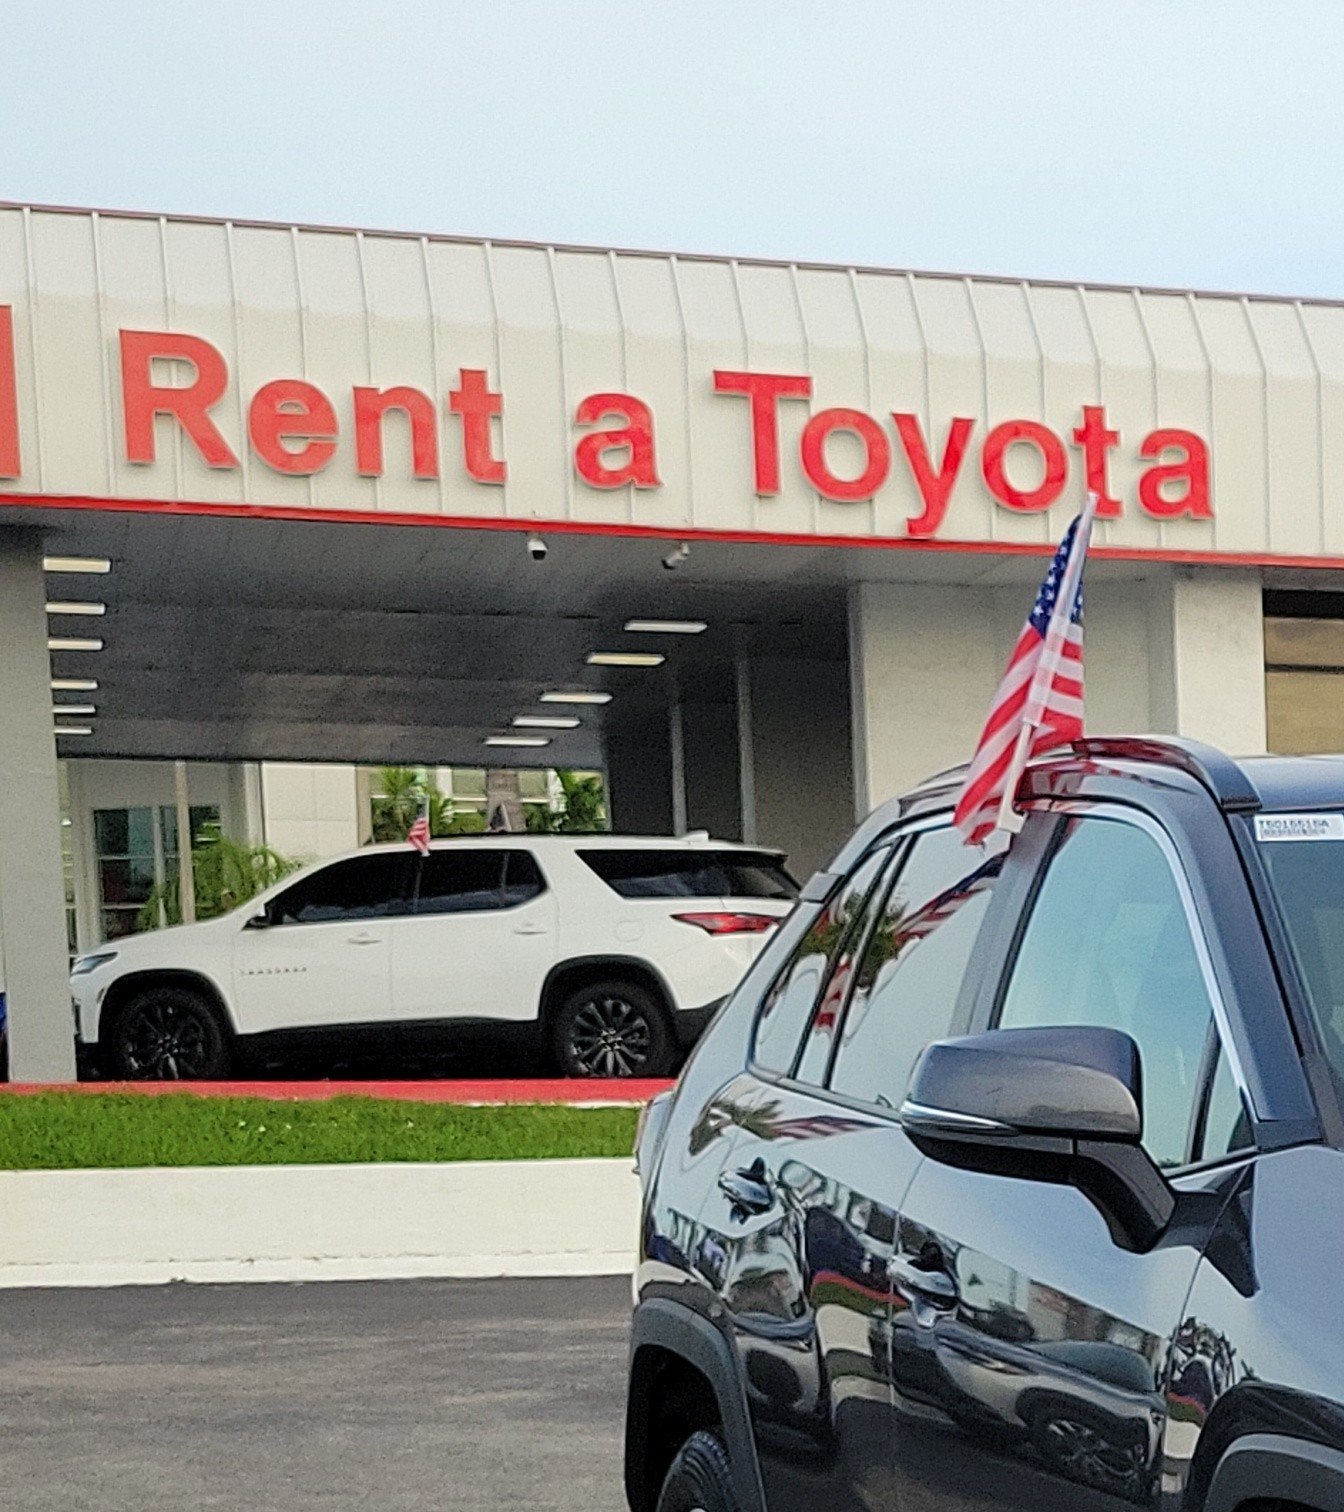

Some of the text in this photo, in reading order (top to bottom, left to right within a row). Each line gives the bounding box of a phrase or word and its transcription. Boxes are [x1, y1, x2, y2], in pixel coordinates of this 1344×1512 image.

[119, 329, 508, 485] Rent
[573, 392, 662, 490] a
[713, 370, 1215, 541] Toyota
